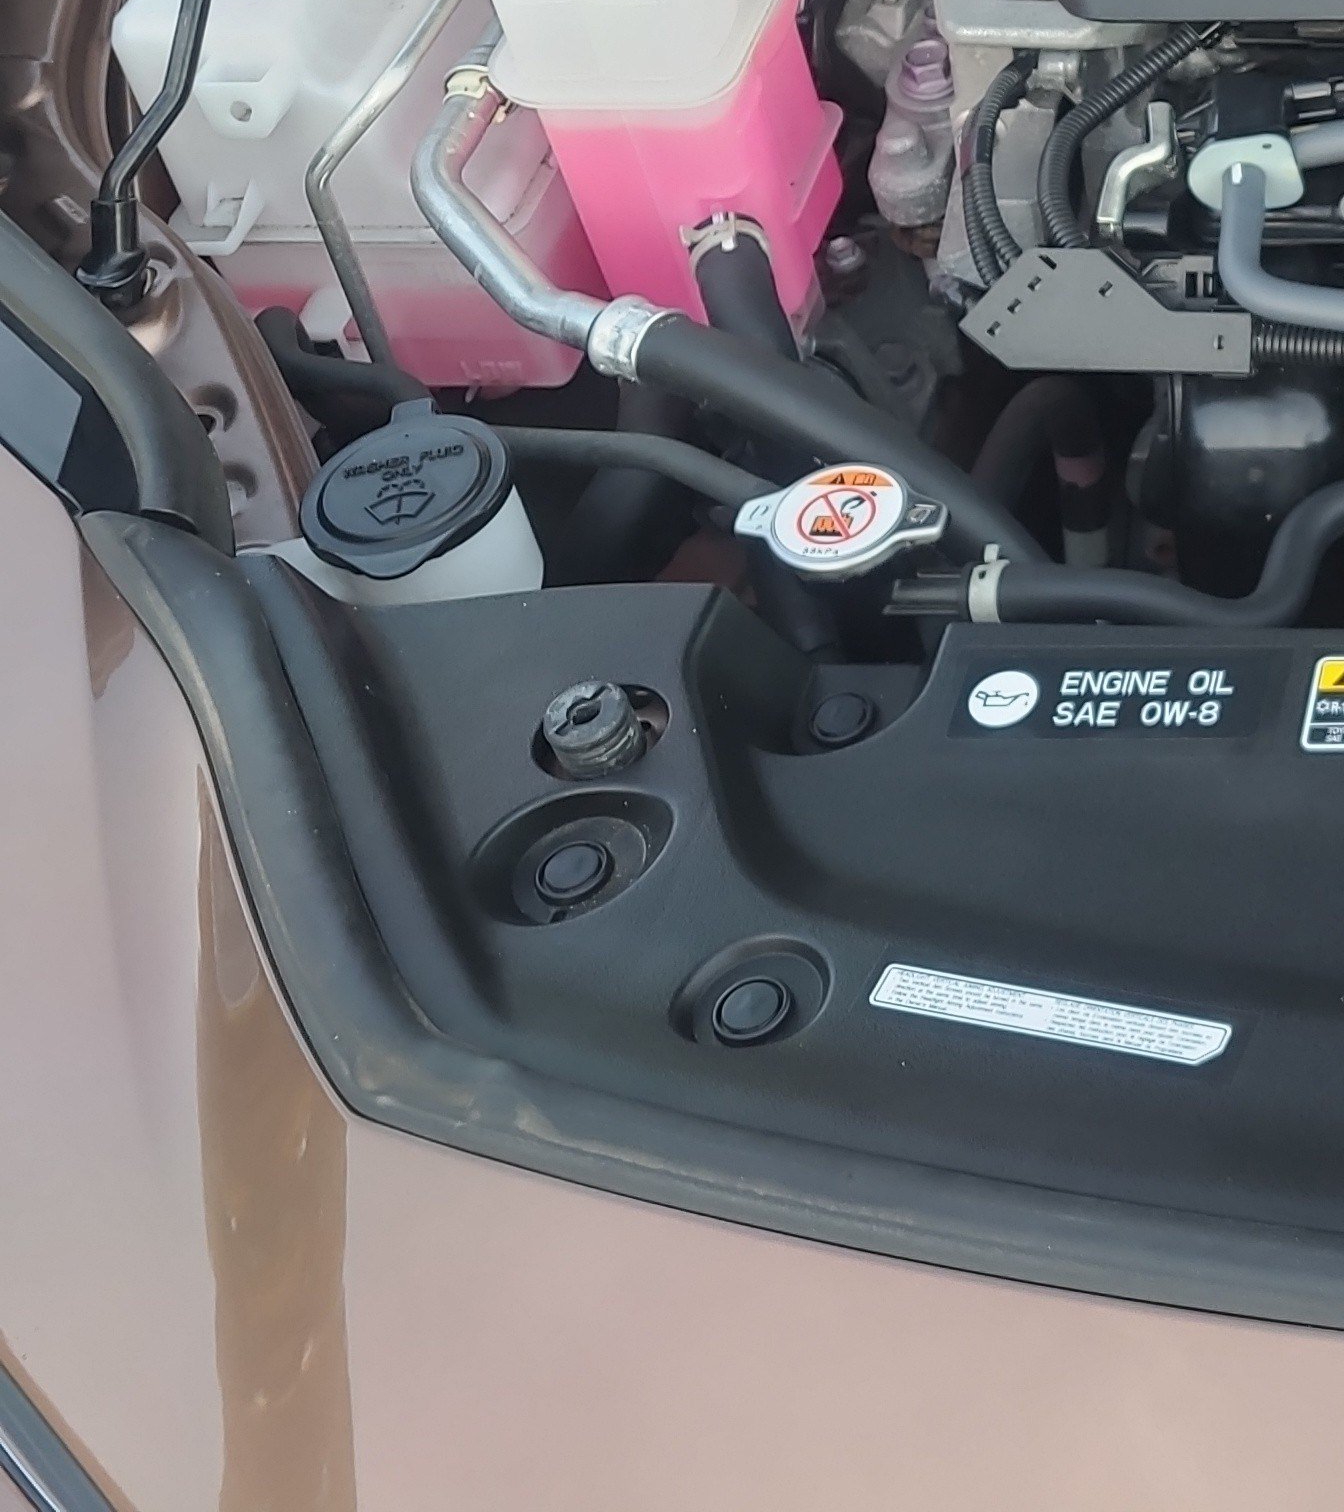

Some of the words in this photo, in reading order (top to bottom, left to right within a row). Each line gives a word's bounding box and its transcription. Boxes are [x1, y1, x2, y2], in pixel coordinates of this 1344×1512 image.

[1060, 670, 1172, 696] ENGINE
[1187, 670, 1234, 696] OIL
[1052, 701, 1122, 727] SAE
[1140, 701, 1222, 727] 0W-8
